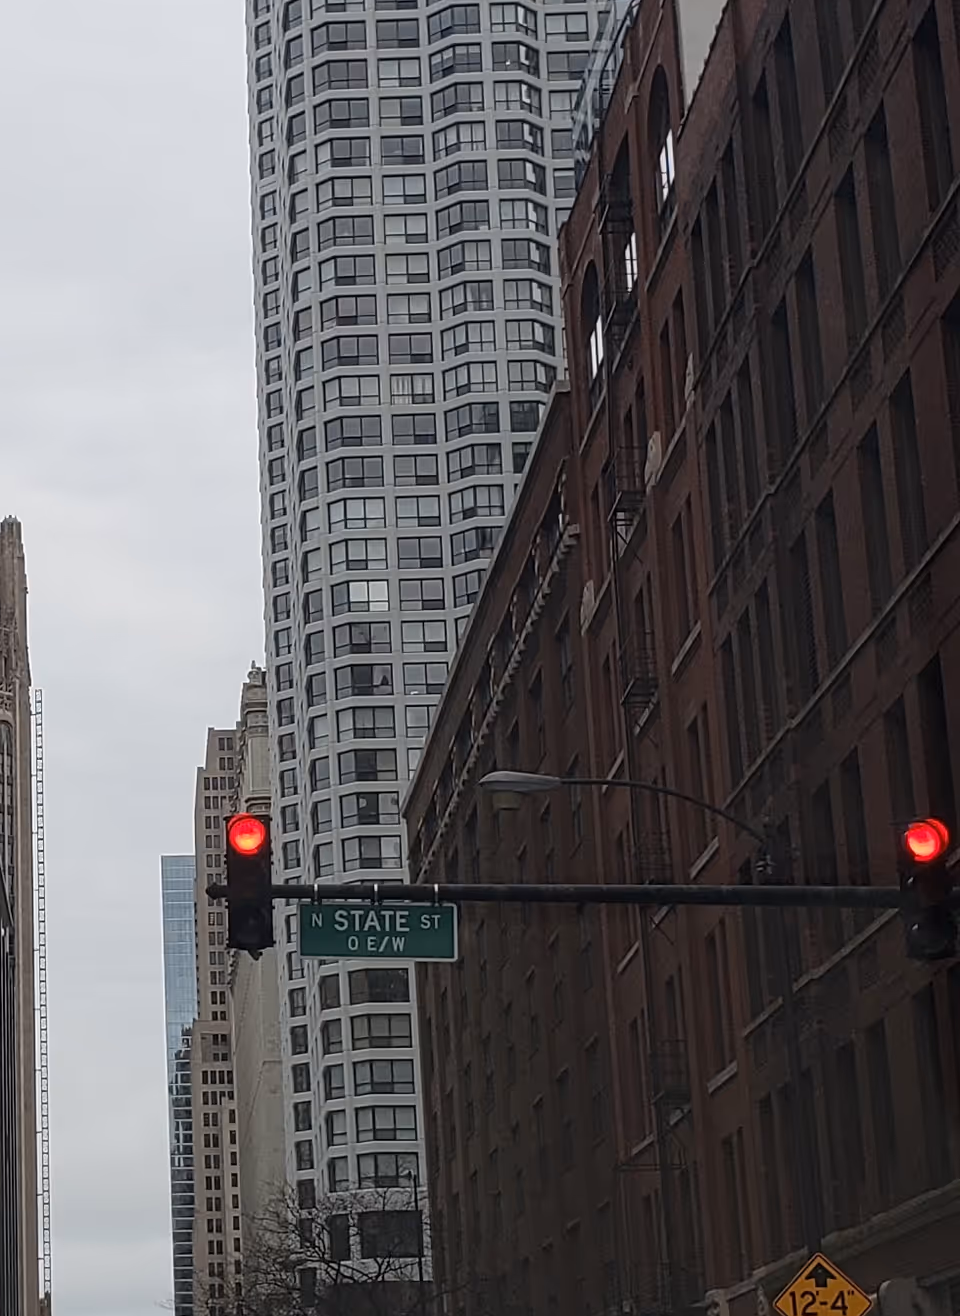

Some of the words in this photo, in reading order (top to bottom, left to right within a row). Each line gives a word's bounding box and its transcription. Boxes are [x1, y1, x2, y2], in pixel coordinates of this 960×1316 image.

[311, 913, 323, 928] N
[334, 910, 410, 932] STATE
[420, 914, 441, 929] ST
[367, 936, 405, 952] E/W
